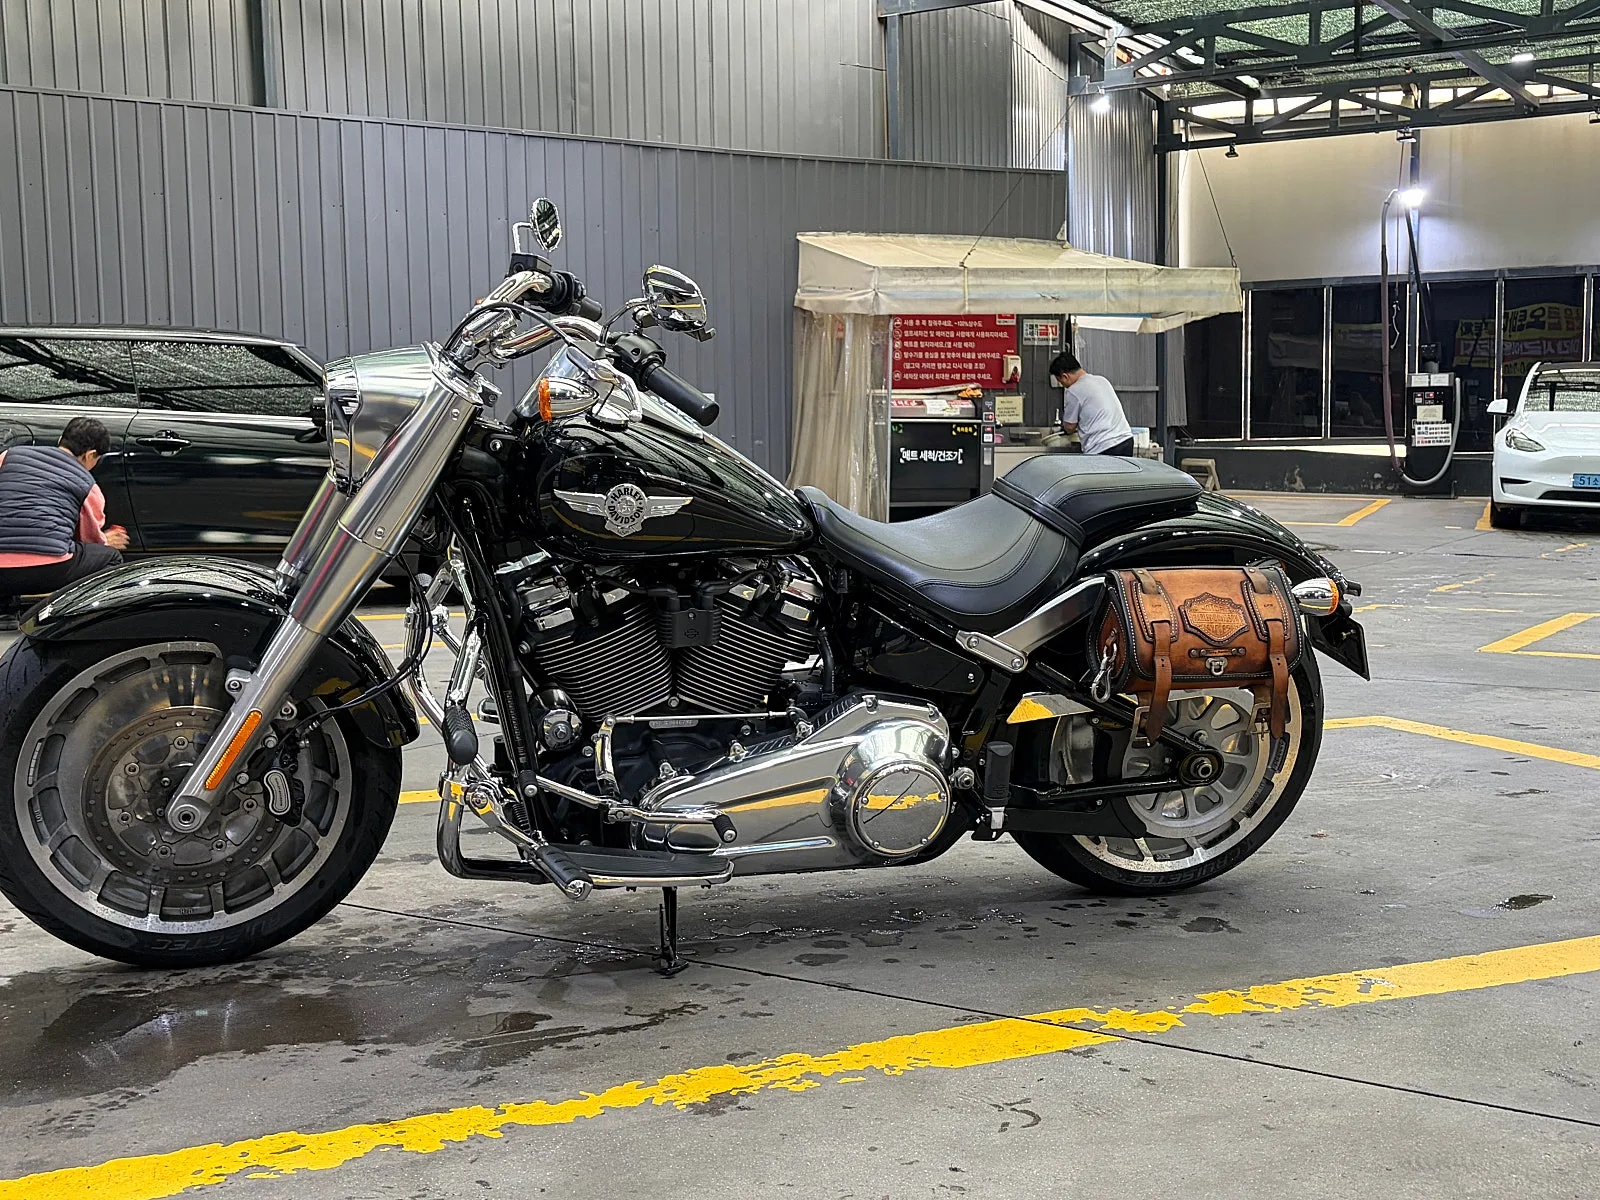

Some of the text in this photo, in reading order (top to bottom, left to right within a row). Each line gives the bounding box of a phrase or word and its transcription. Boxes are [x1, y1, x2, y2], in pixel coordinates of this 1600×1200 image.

[1039, 324, 1058, 336] 금지
[903, 450, 960, 462] 매트 세척/건조기
[610, 488, 643, 502] HARLEY
[608, 506, 643, 524] DAVIDSON
